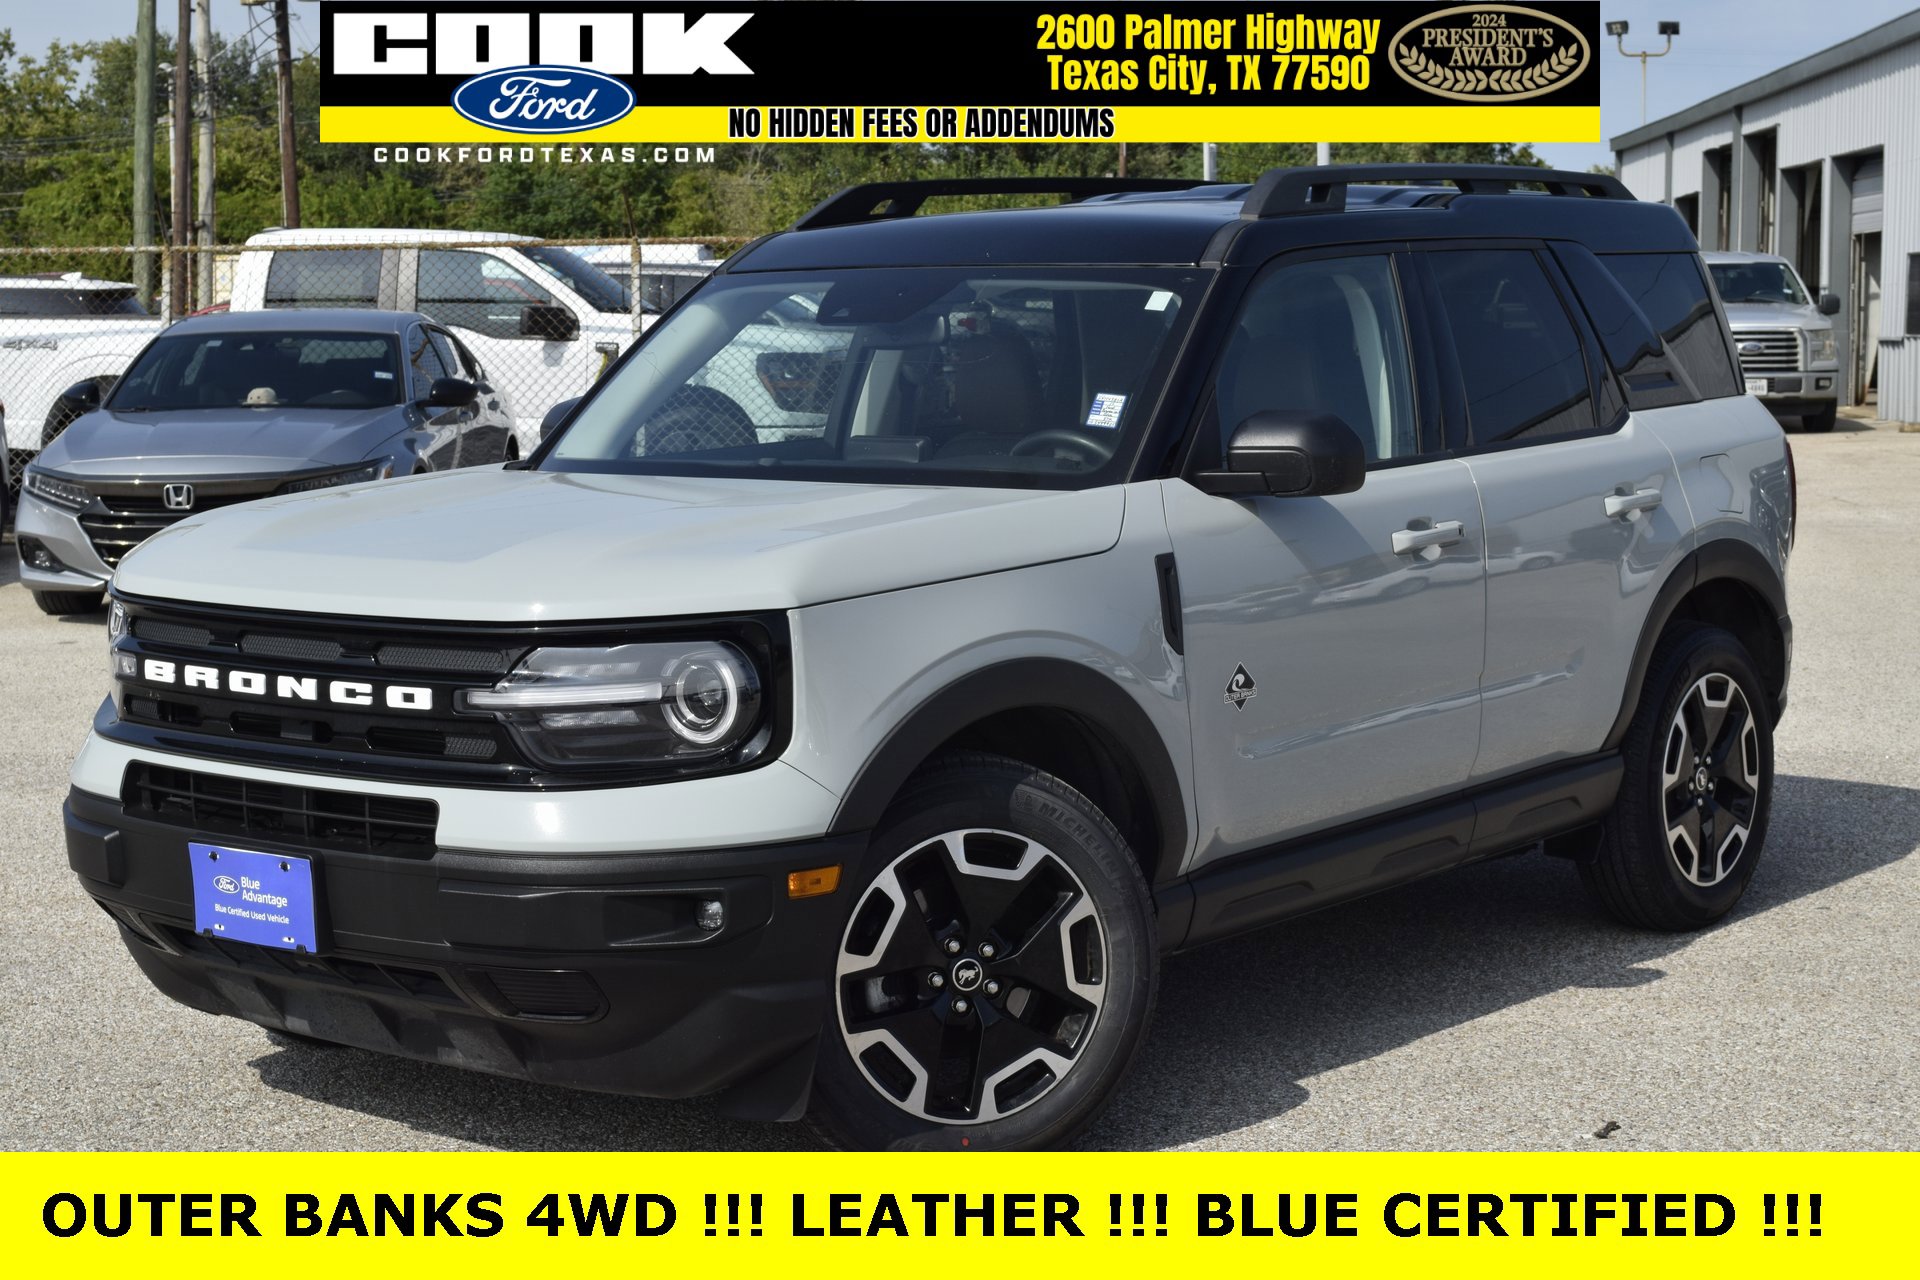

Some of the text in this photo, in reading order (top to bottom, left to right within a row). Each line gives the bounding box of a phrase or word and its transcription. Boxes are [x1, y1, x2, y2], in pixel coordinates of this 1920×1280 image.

[144, 658, 433, 710] BRONCO
[218, 877, 235, 892] Ford
[241, 876, 260, 889] Blue
[242, 890, 288, 908] Advantage
[215, 904, 289, 924] Blue Certified Used Vehicle
